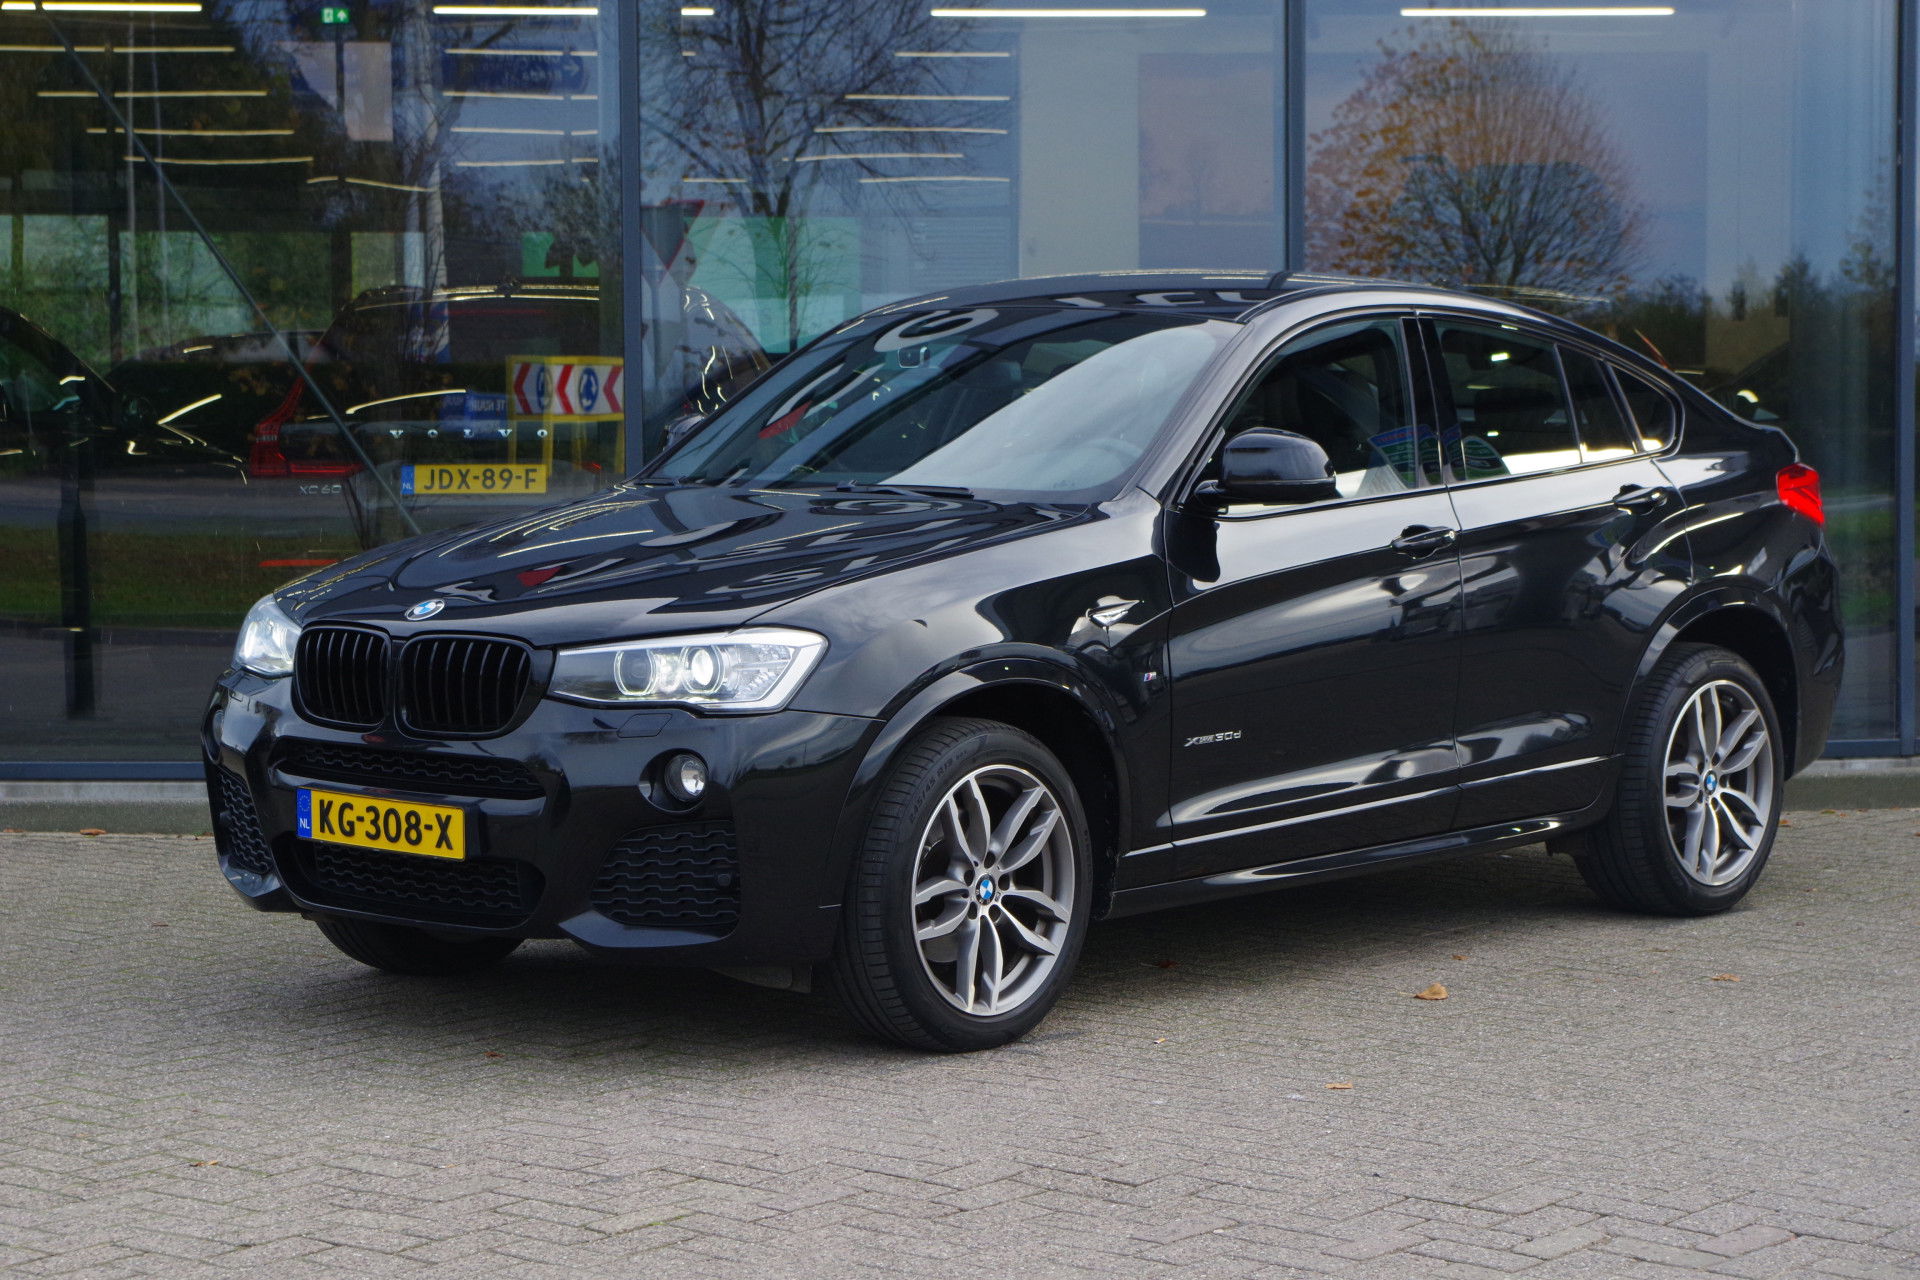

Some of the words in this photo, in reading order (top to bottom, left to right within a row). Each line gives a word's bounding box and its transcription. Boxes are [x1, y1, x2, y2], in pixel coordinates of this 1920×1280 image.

[389, 428, 548, 439] VOLVO
[423, 468, 538, 490] JDX-89-F
[299, 817, 311, 830] NL
[318, 798, 454, 851] KG-308-X
